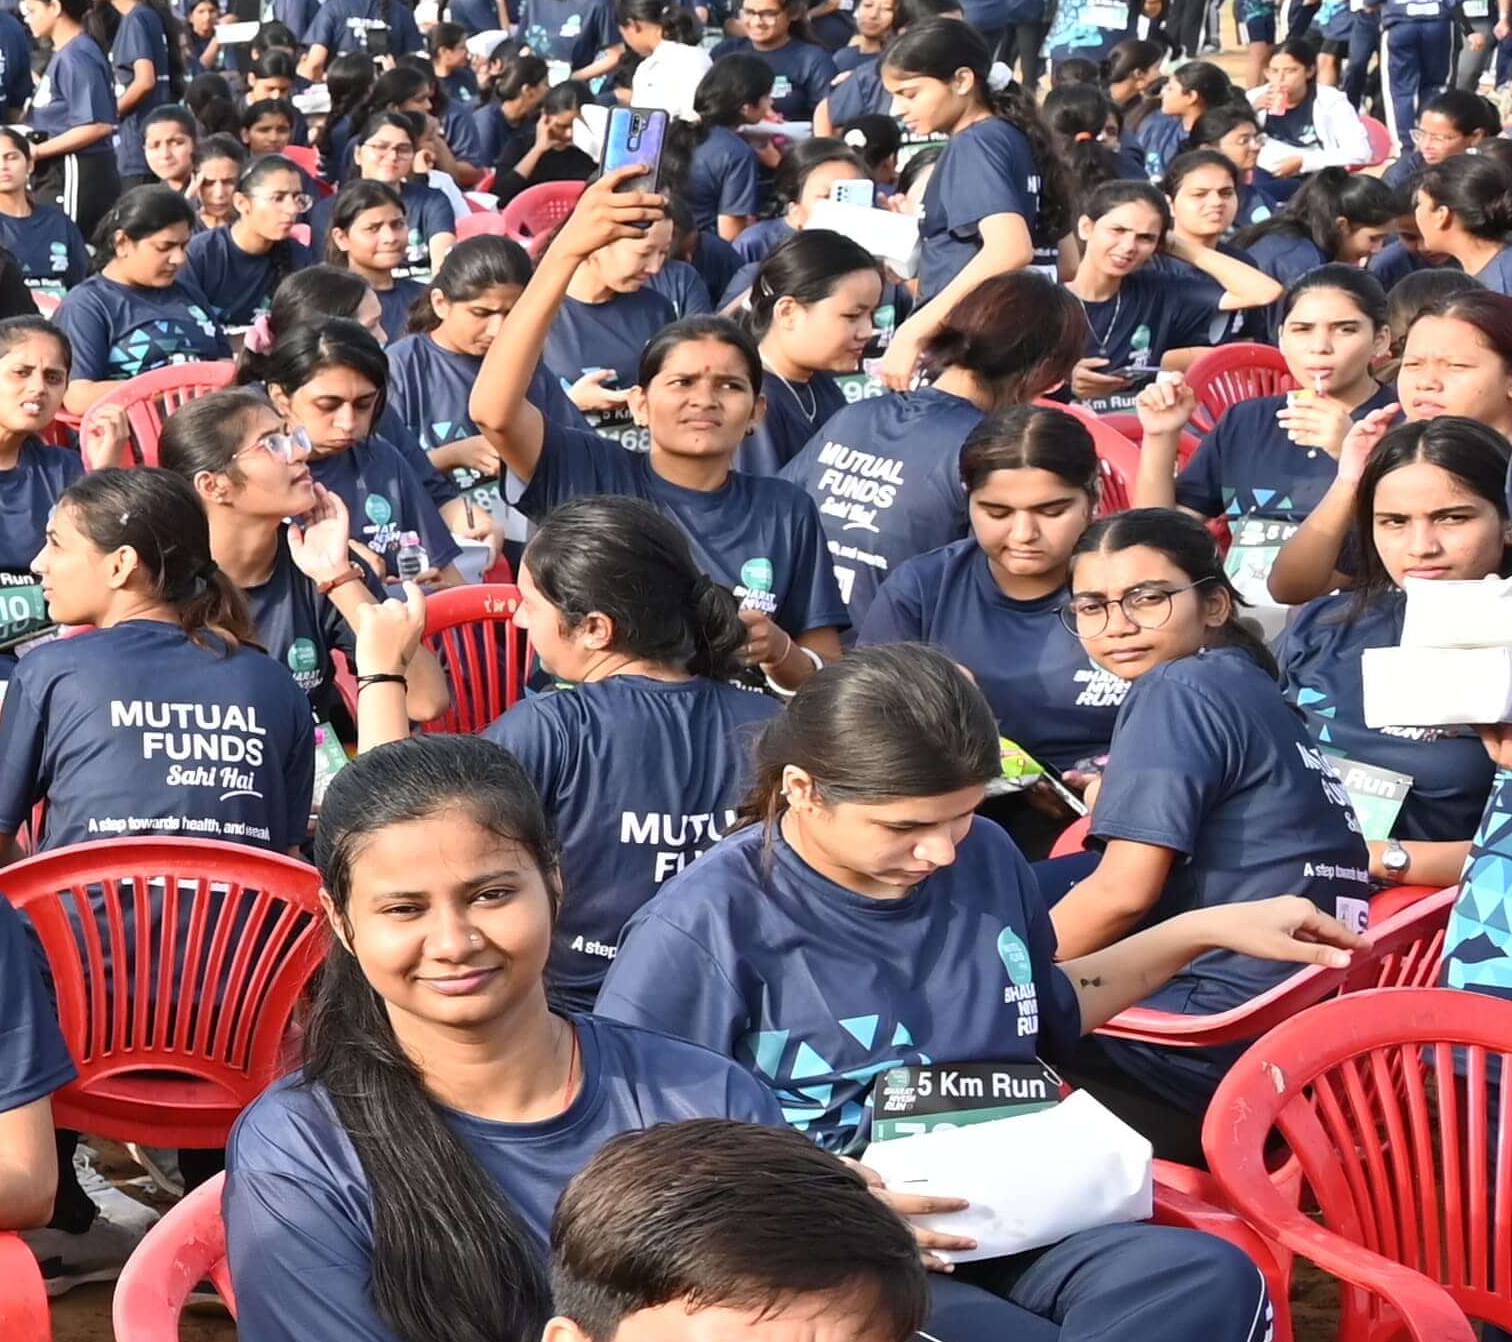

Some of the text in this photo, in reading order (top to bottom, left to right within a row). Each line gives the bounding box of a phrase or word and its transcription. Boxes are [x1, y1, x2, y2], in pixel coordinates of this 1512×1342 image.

[818, 441, 904, 486] MUTUAL
[818, 469, 897, 509] FUNDS
[0, 571, 35, 585] Run
[1075, 692, 1126, 707] RUN
[111, 700, 266, 736] MUTUAL
[143, 732, 264, 767] FUNDS
[166, 763, 254, 791] Sahi Hai
[1345, 766, 1397, 799] Run
[89, 815, 244, 836] A step towards health, and
[1304, 863, 1314, 877] A
[571, 935, 587, 953] A
[917, 1072, 1047, 1099] 5 Km Run
